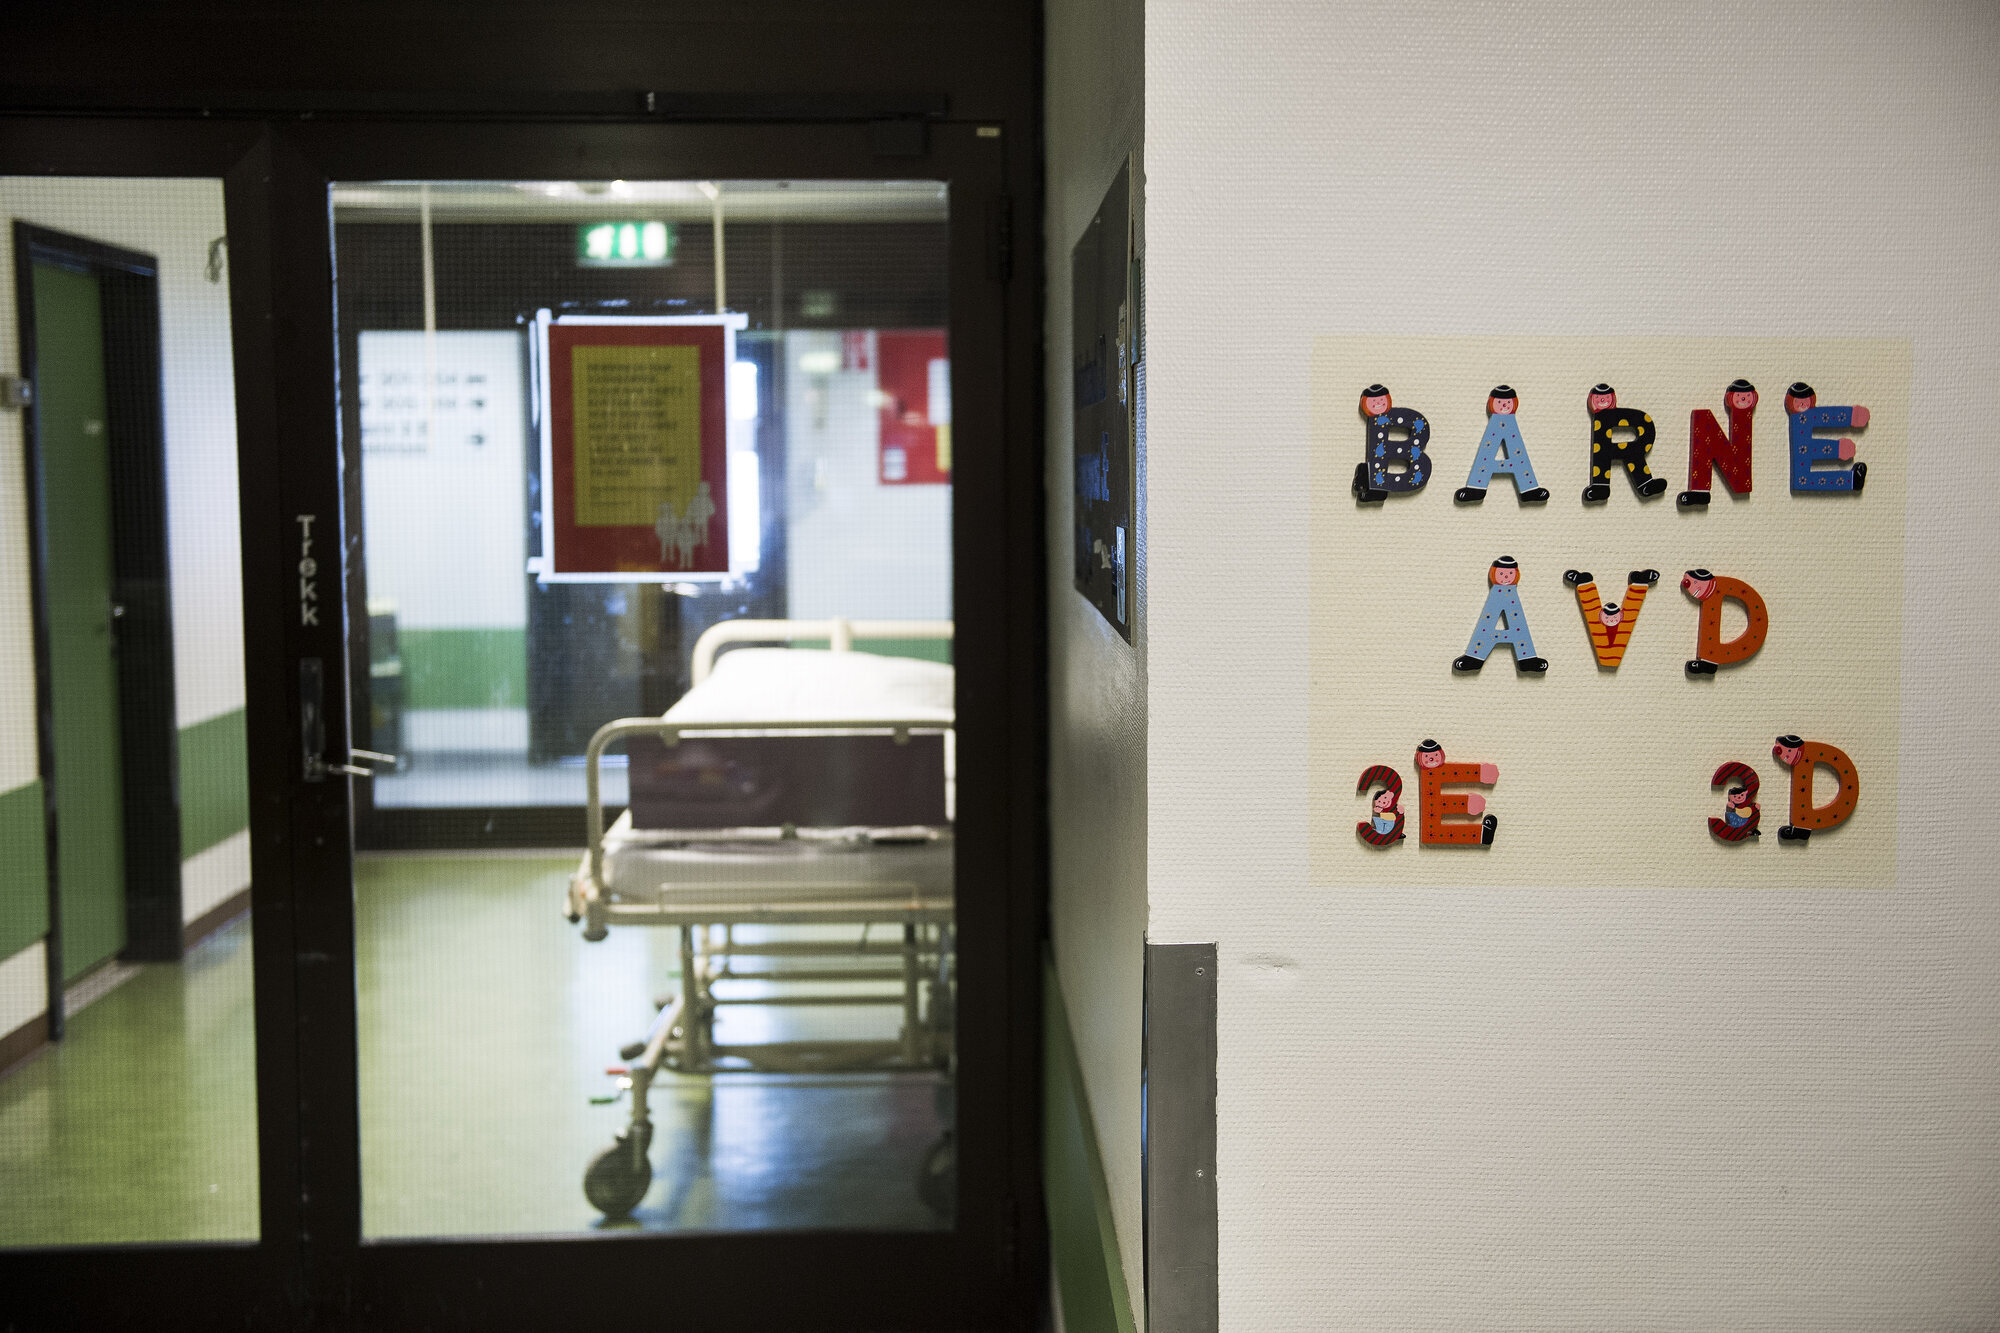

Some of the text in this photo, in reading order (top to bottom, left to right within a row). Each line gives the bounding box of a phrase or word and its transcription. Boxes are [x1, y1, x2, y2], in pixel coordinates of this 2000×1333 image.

[1353, 379, 1870, 506] BARNE
[296, 514, 319, 626] Trekk
[1452, 556, 1769, 674] AVD
[1356, 734, 1860, 846] 3E 3D
